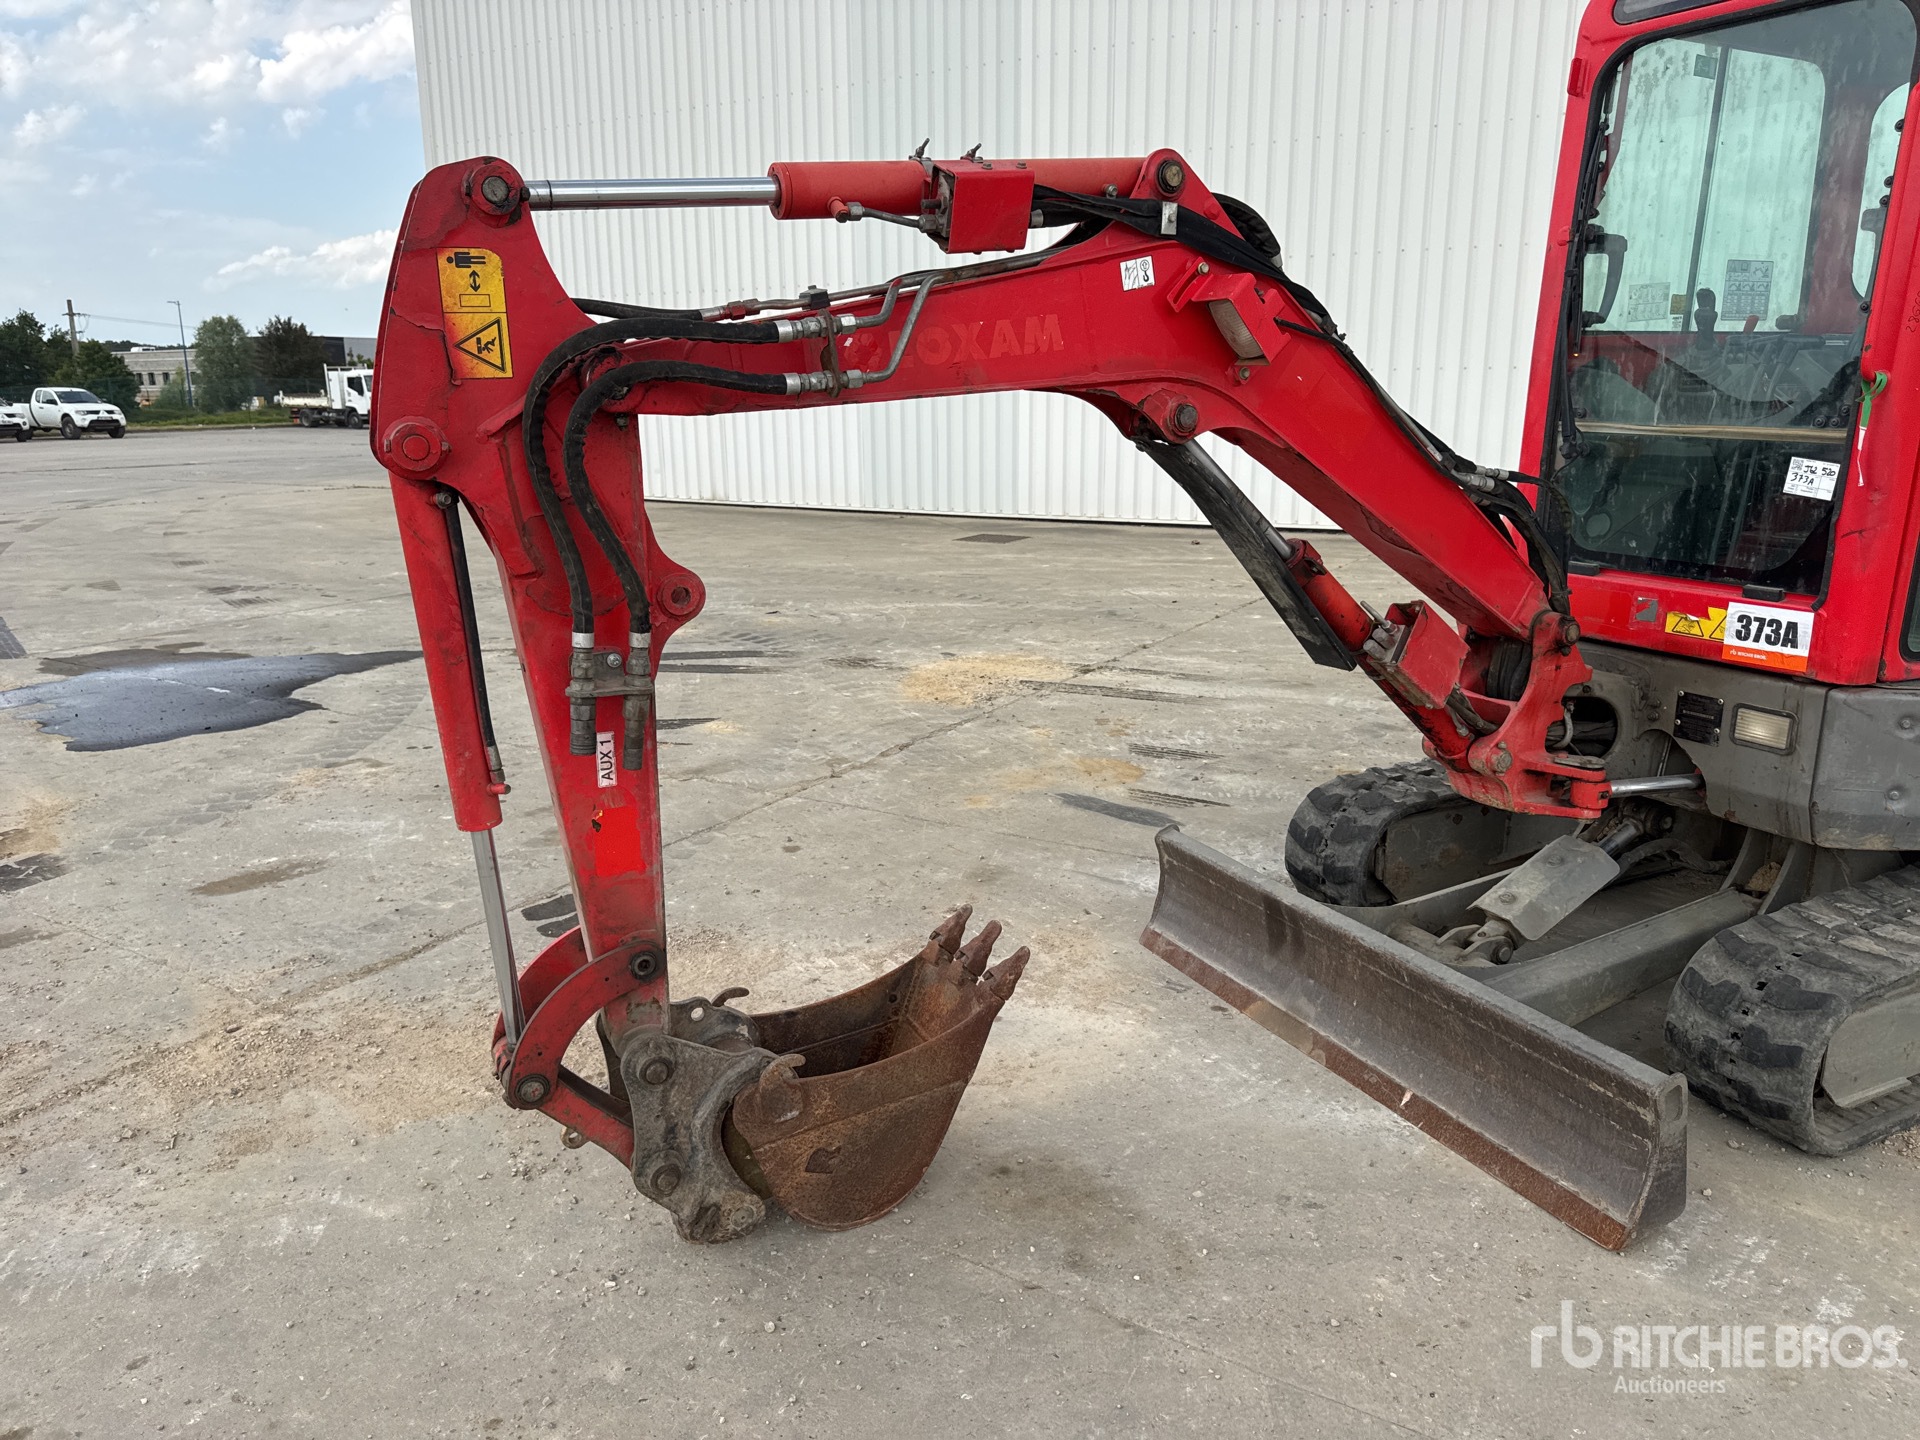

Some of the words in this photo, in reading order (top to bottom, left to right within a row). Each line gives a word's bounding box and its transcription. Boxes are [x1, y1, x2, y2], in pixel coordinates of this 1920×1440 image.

[888, 313, 1064, 369] LOXAM
[1790, 472, 1815, 486] 373A
[1821, 466, 1836, 477] 520
[1735, 614, 1799, 649] 373A
[600, 750, 613, 780] AUX
